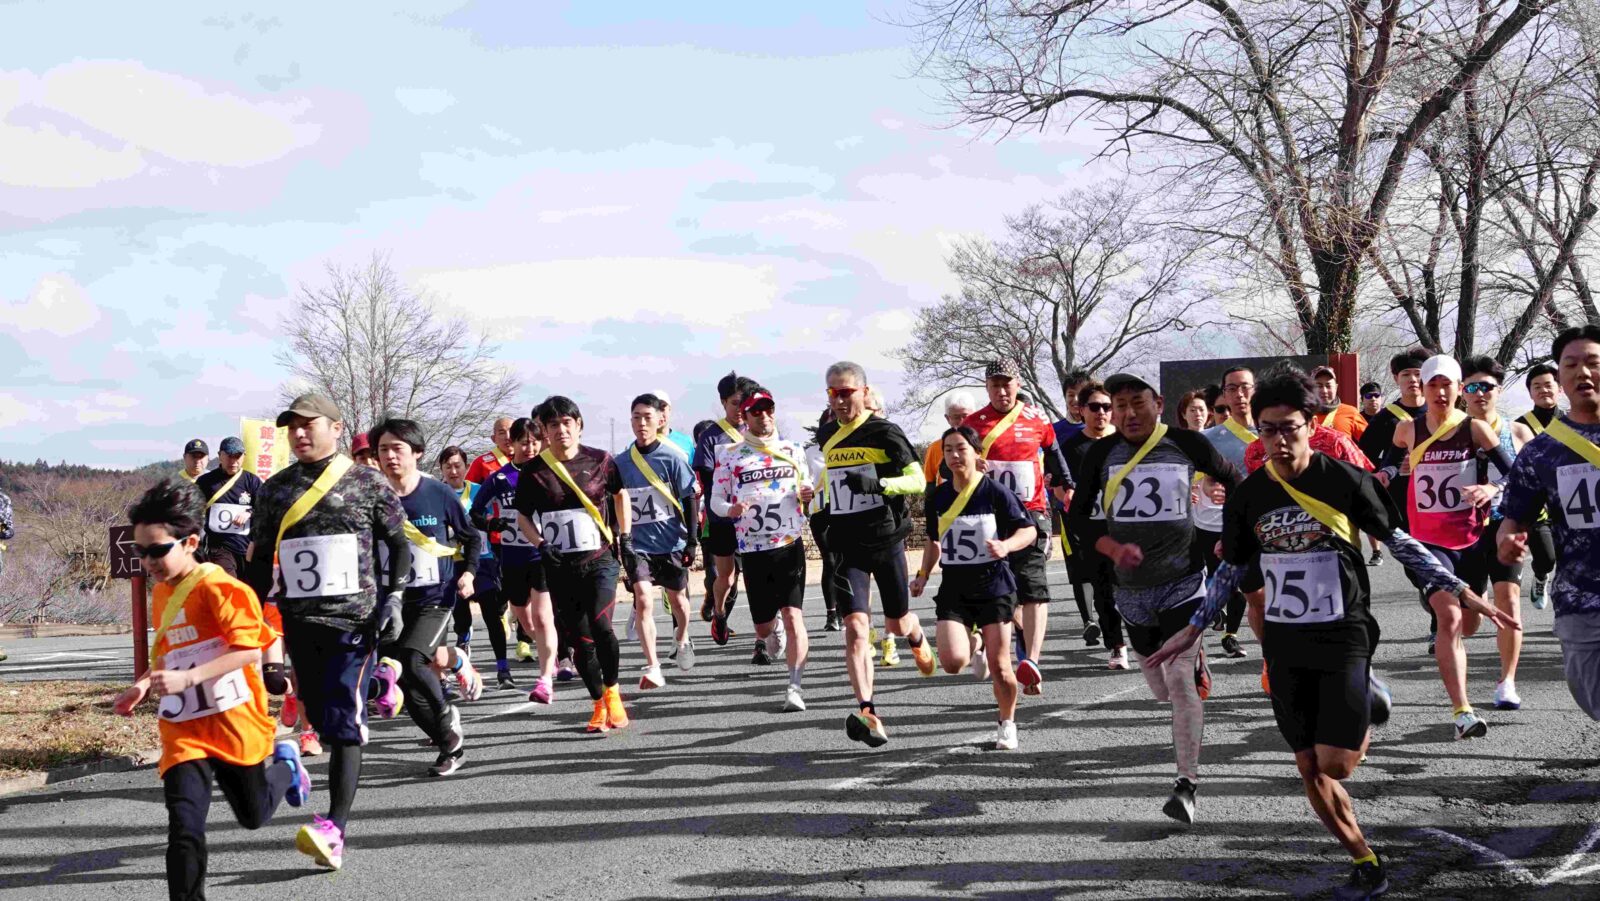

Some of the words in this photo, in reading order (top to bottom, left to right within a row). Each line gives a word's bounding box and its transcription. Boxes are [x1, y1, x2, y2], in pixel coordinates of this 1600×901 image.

[827, 451, 866, 463] KANAN
[742, 467, 793, 482] 石のセガワ
[1115, 476, 1184, 518] 23-1
[748, 502, 795, 533] 35-1
[545, 519, 597, 551] 21-1
[115, 556, 143, 575] 入口
[294, 549, 351, 592] 3-1
[1265, 568, 1337, 619] 25-1
